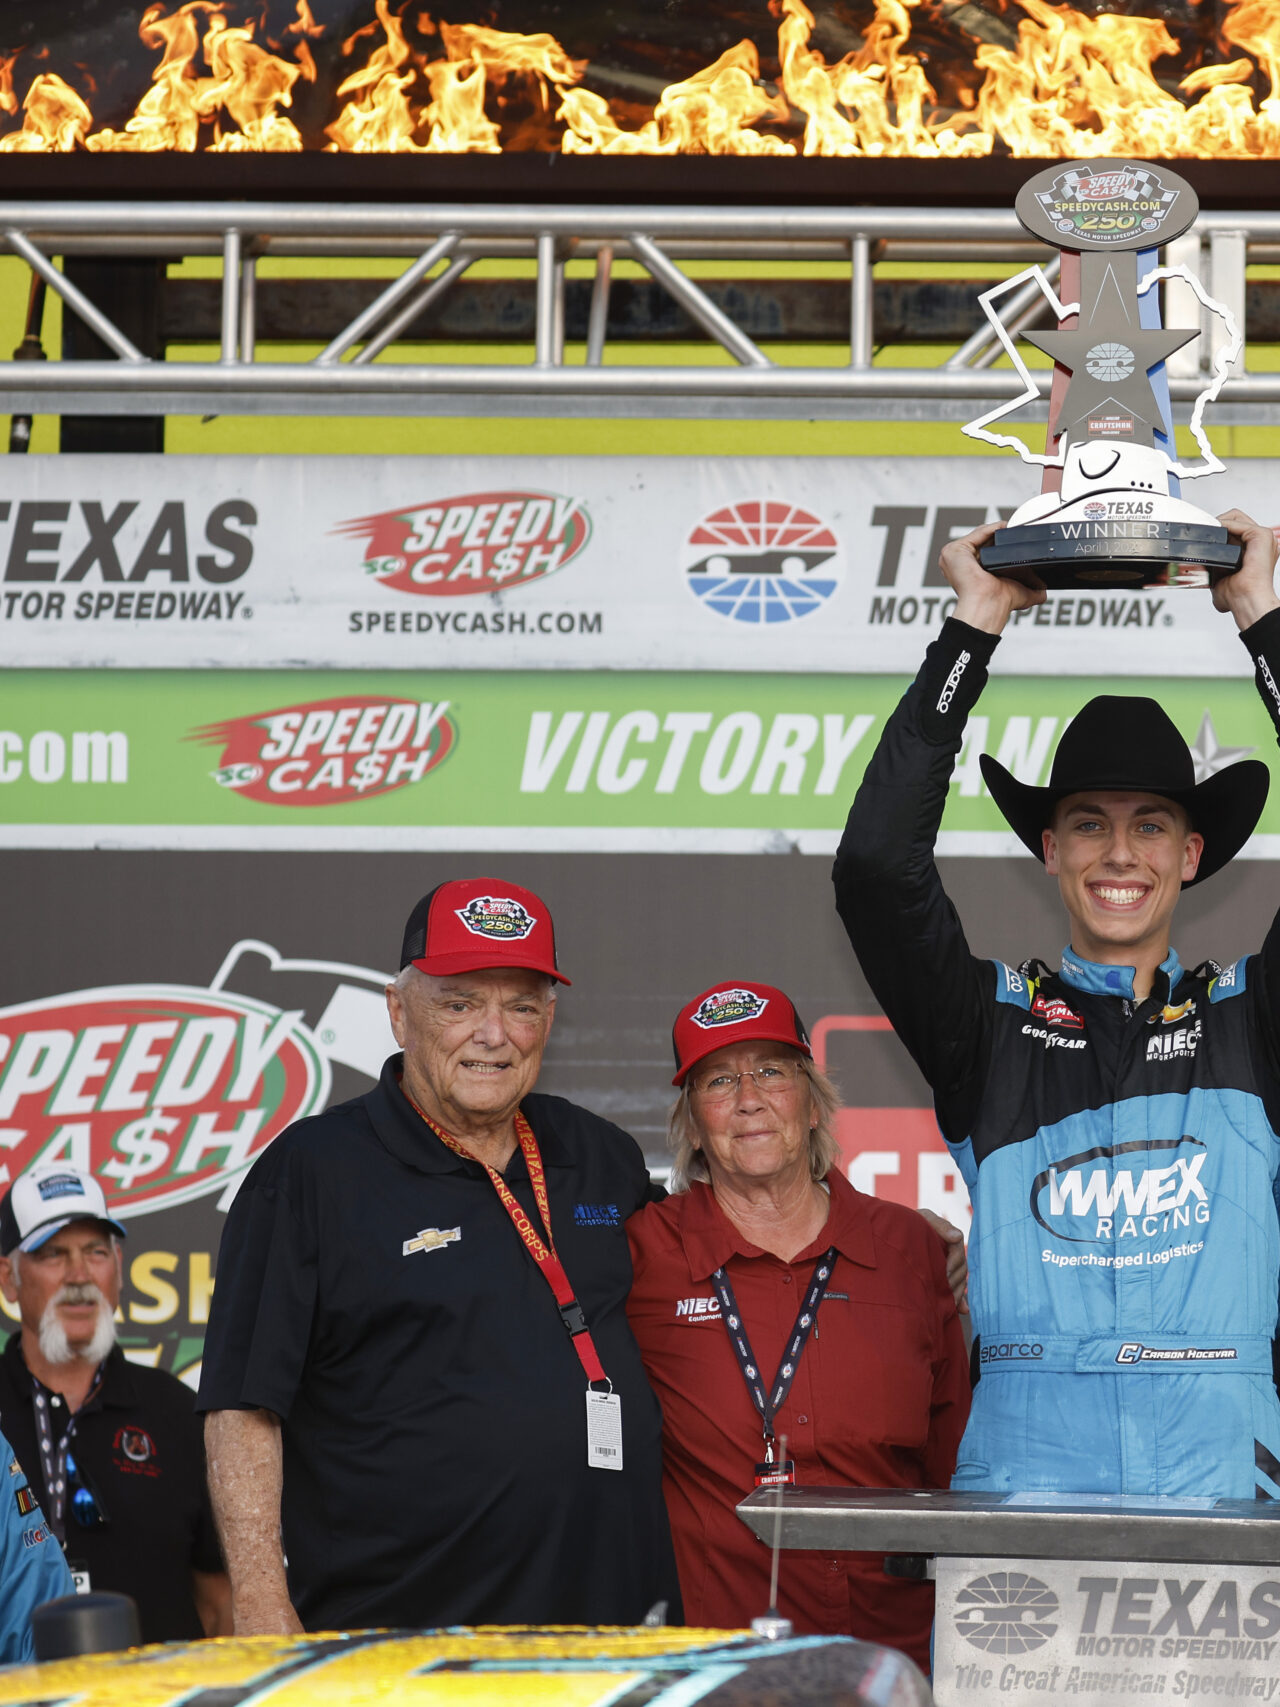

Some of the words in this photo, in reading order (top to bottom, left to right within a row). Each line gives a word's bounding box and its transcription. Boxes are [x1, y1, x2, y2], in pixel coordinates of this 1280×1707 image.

[1088, 173, 1133, 189] SPEEDY
[1054, 201, 1161, 213] SPEEDYCASH.COM
[1079, 213, 1135, 230] 250
[1073, 227, 1092, 240] TEXAS
[1112, 227, 1142, 241] SPEEDWAY
[1107, 501, 1154, 515] TEXAS
[403, 497, 584, 553] SPEEDY
[1060, 522, 1160, 539] WINNER
[0, 500, 258, 584] EXAS
[1074, 541, 1102, 556] April
[1114, 541, 1144, 554] 202
[74, 591, 244, 620] SPEEDWAY
[869, 597, 958, 625] MOTO
[348, 611, 604, 634] SPEEDYCASH.COM
[936, 649, 972, 714] sparco
[261, 700, 451, 760] SPEEDY
[520, 710, 876, 796] VICTORY
[470, 914, 525, 926] SPEEDYCASH.COM
[485, 921, 513, 931] 250
[716, 1007, 744, 1020] 250
[1021, 1024, 1087, 1050] GOOYEAR
[0, 1009, 305, 1118] PEEDY
[511, 1208, 549, 1262] CORPS
[1041, 1249, 1144, 1269] Supercharged
[1146, 1240, 1205, 1266] Logistics
[676, 1297, 722, 1317] NIEC
[688, 1313, 723, 1323] Equipment
[979, 1341, 1044, 1364] sparco
[1075, 1635, 1155, 1657] MOTOR
[1159, 1637, 1279, 1661] SPEEDWAY
[955, 1663, 993, 1690] The
[999, 1663, 1060, 1693] Great
[1065, 1665, 1167, 1694] American
